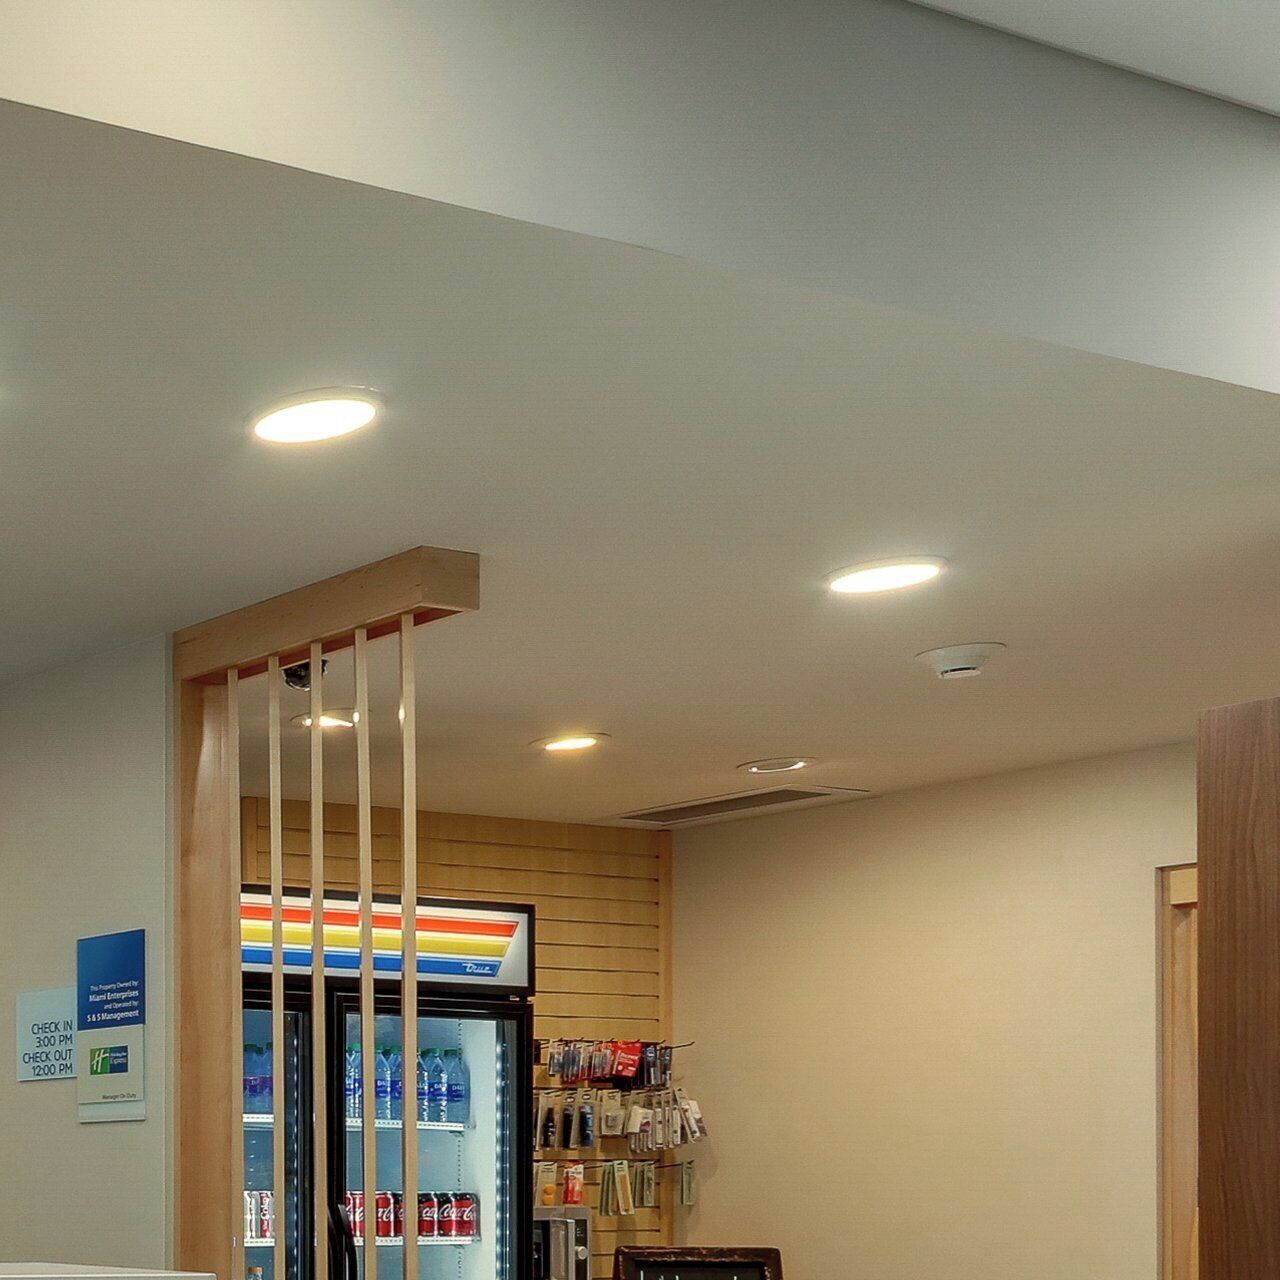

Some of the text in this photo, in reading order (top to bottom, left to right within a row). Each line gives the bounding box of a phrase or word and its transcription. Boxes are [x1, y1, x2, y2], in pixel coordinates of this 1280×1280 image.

[89, 990, 139, 1002] Miami Enterprises
[87, 1014, 92, 1022] S
[97, 1013, 101, 1021] S
[101, 1009, 139, 1020] Management
[31, 1020, 72, 1034] CHECK IN
[35, 1033, 73, 1048] 3:00 PM
[22, 1049, 73, 1064] CHECK OUT
[32, 1062, 73, 1076] 12:00 PM
